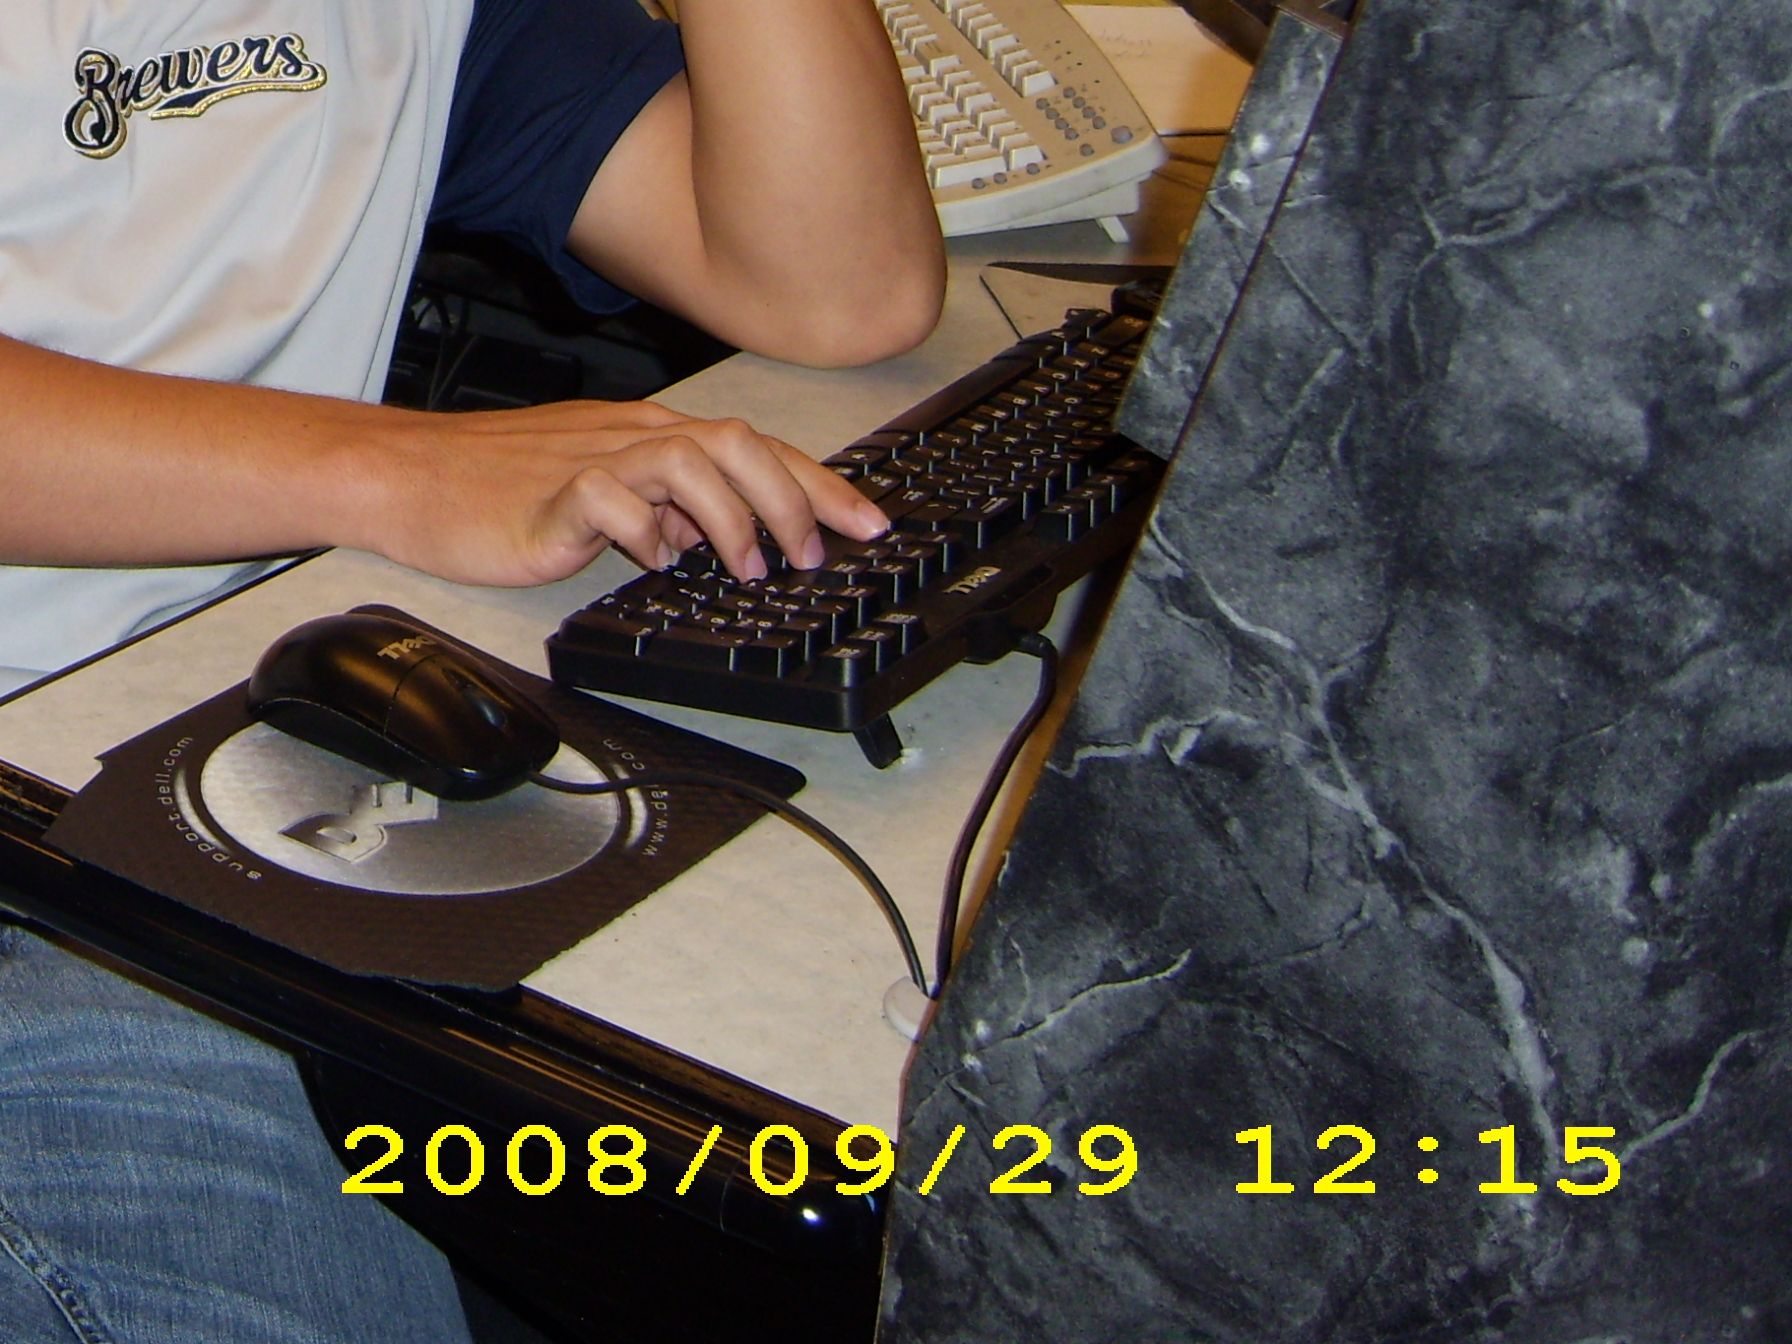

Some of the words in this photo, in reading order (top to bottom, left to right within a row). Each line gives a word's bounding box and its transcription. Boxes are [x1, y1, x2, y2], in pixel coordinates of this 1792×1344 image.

[63, 32, 328, 160] Brewers
[942, 565, 1002, 595] DELL
[156, 736, 262, 880] support.dell.com
